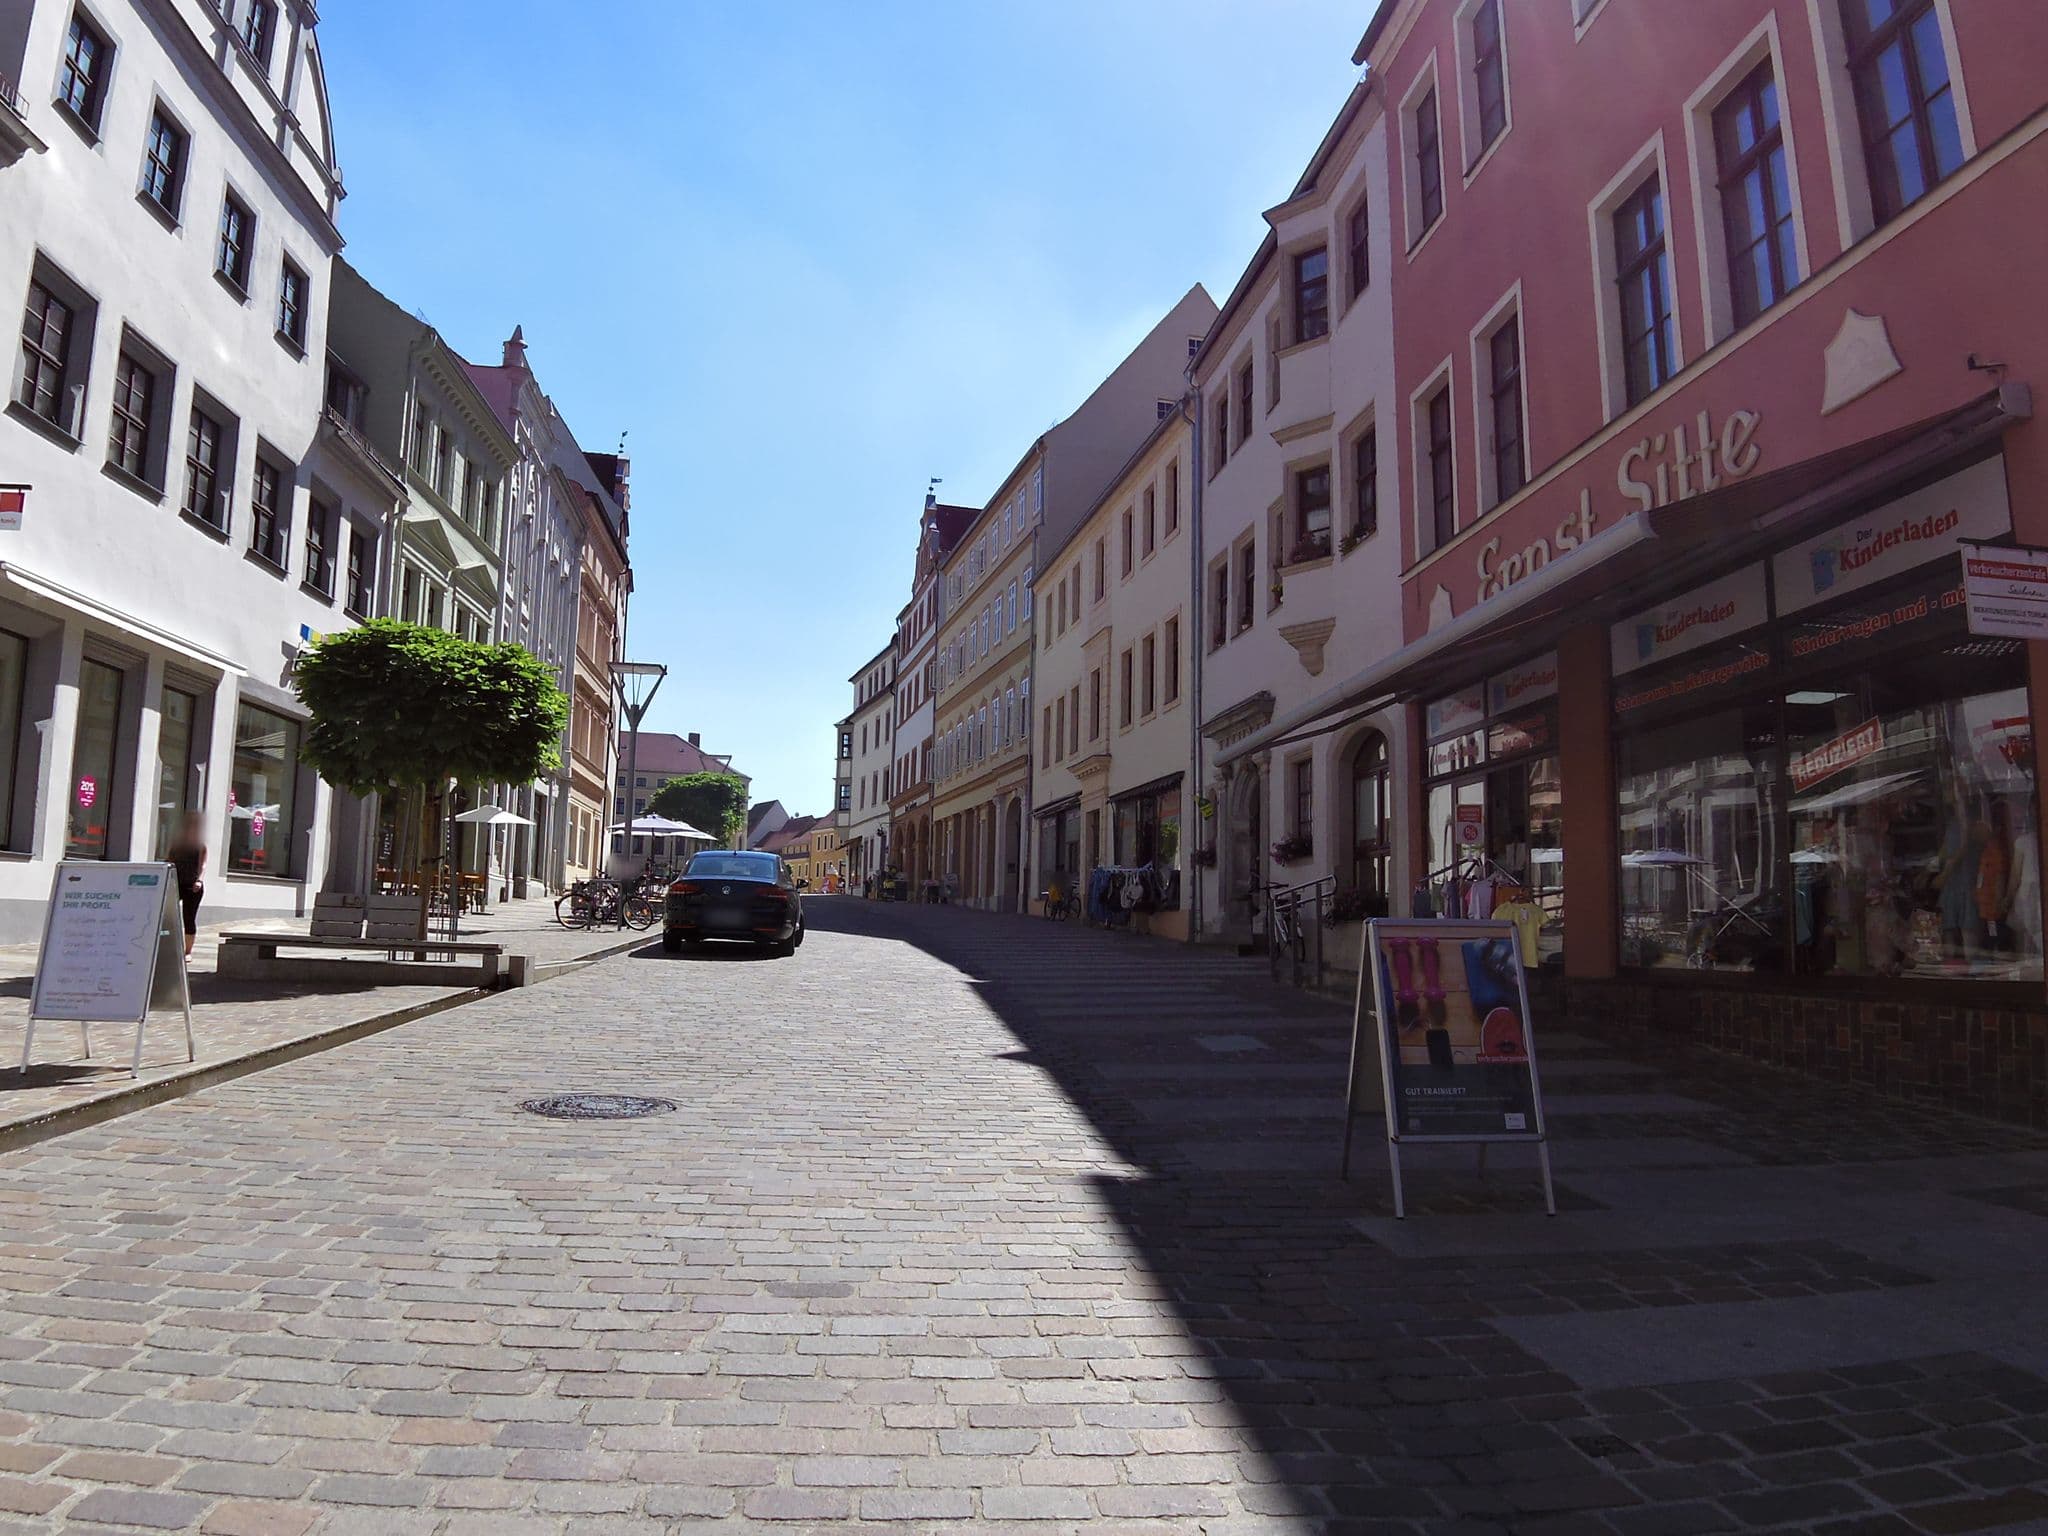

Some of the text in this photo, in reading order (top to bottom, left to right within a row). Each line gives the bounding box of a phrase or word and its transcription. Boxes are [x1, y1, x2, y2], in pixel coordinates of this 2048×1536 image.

[1476, 410, 1761, 604] Ernst Sitte
[1840, 510, 1959, 572] Kinderladen
[1857, 528, 1873, 542] Der
[1655, 600, 1735, 644] Kinderladen
[1792, 613, 1890, 657] Kinderwagen
[1893, 596, 1928, 625] und
[84, 891, 121, 901] SUCHEN
[1405, 1087, 1467, 1096] GUT TRAINIERT?
